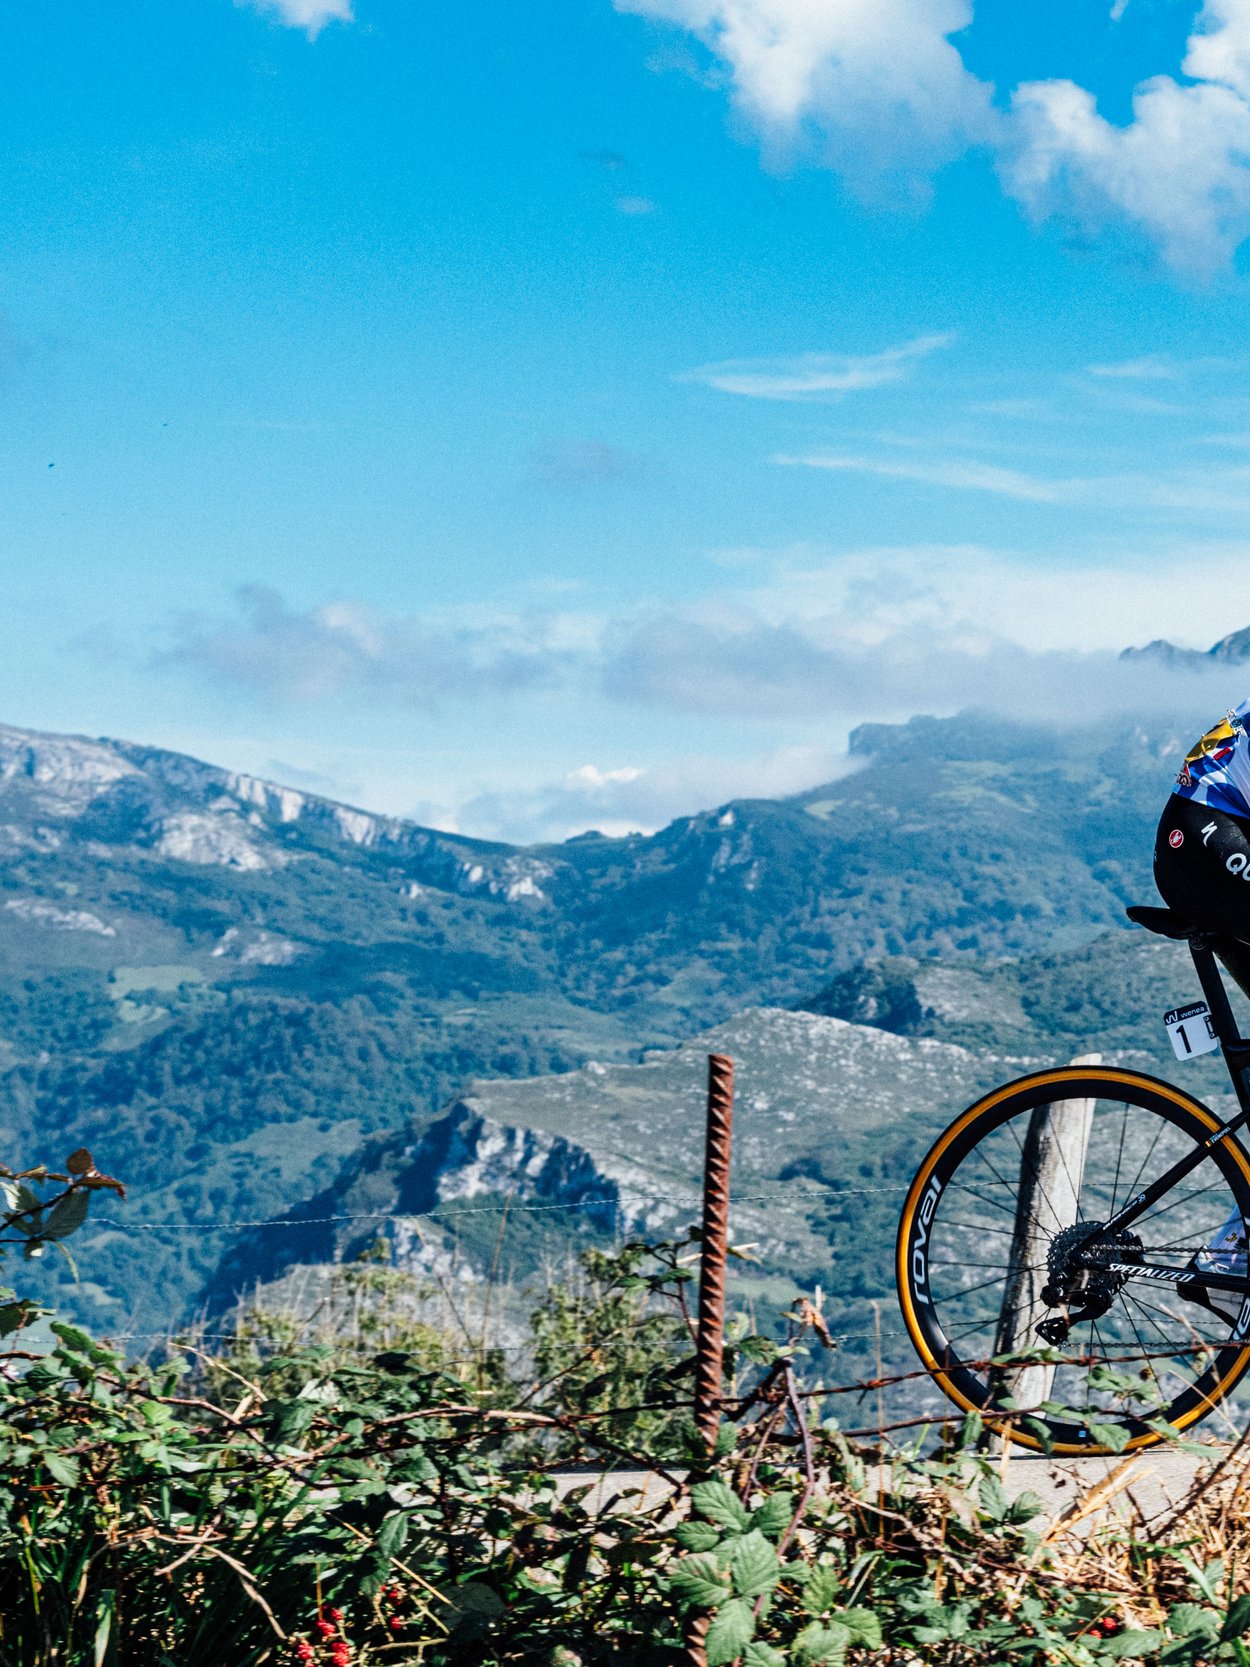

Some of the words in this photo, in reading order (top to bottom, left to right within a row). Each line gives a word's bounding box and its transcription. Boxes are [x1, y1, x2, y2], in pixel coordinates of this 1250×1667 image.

[1175, 1024, 1192, 1053] 1
[913, 1175, 942, 1305] roval
[1105, 1263, 1196, 1283] SPECIALIZED
